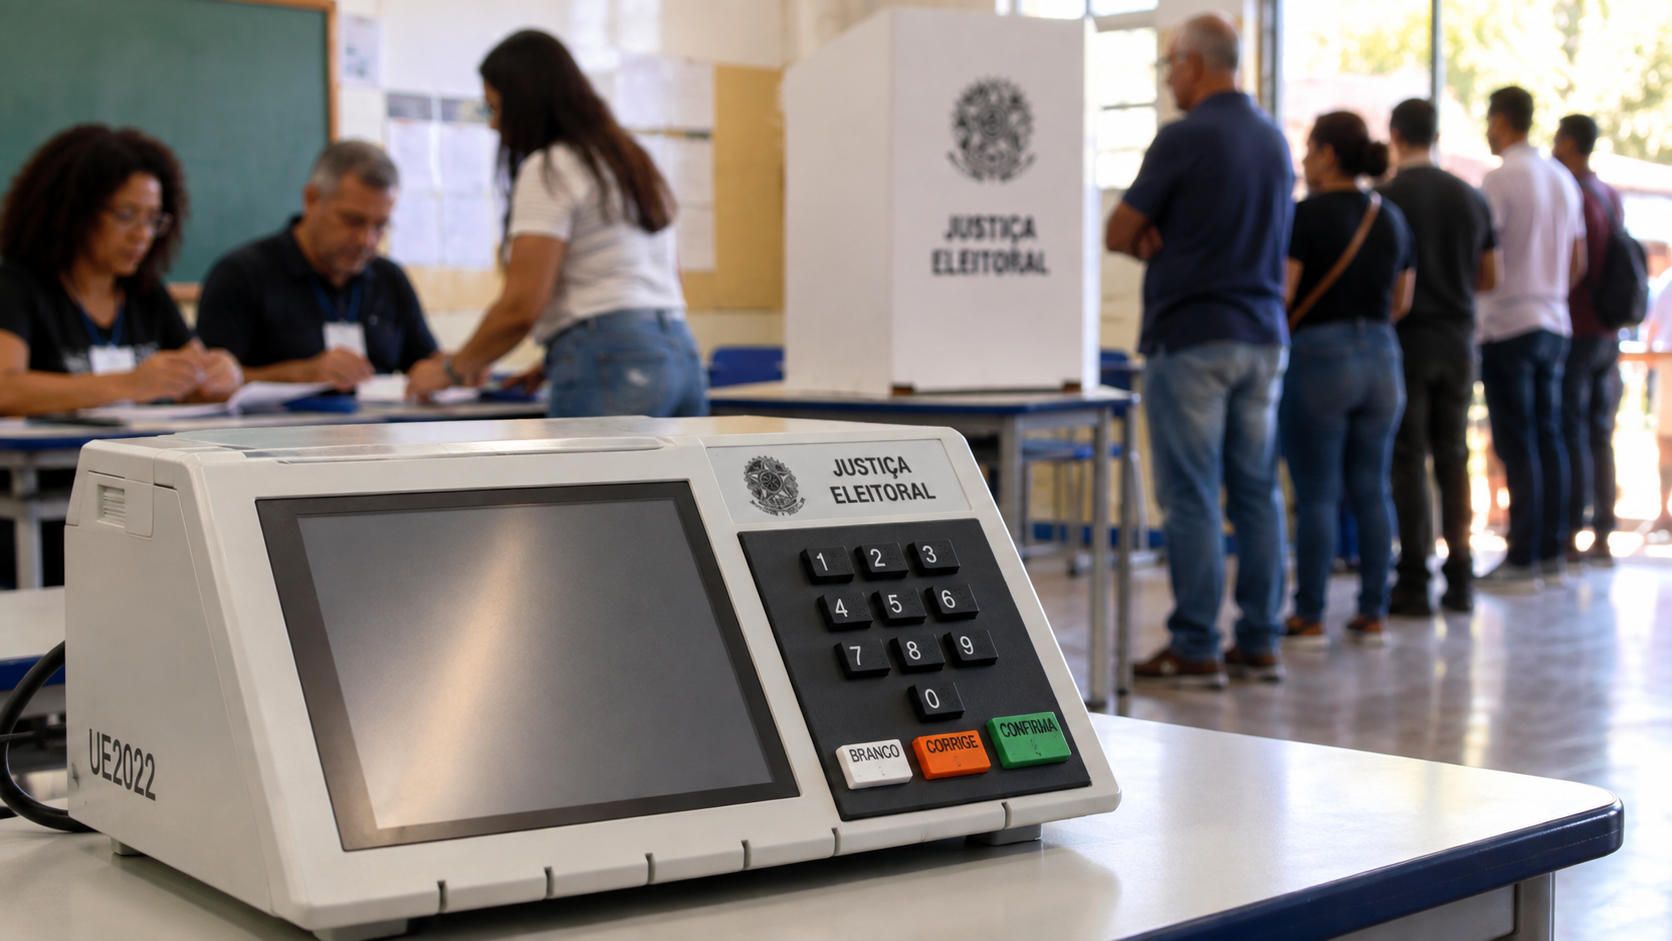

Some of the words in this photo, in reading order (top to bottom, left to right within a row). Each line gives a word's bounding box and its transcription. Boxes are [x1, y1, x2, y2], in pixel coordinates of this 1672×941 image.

[944, 214, 1037, 244] JUSTIÇA
[931, 248, 1051, 276] ELEITORAL
[833, 456, 912, 479] JUSTIÇA
[829, 482, 937, 504] ELEITORAL
[816, 552, 828, 571] 1
[870, 548, 886, 567] 2
[922, 545, 937, 563] 3
[835, 598, 848, 617] 4
[887, 594, 902, 613] 5
[941, 589, 956, 608] 6
[906, 640, 921, 660] 8
[959, 635, 974, 654] 9
[849, 645, 861, 665] 7
[924, 688, 940, 708] 0
[999, 717, 1058, 738] CONFIRMA
[925, 734, 979, 753] CORRIGE
[849, 744, 900, 763] BRANCO
[89, 728, 156, 801] UE2022
